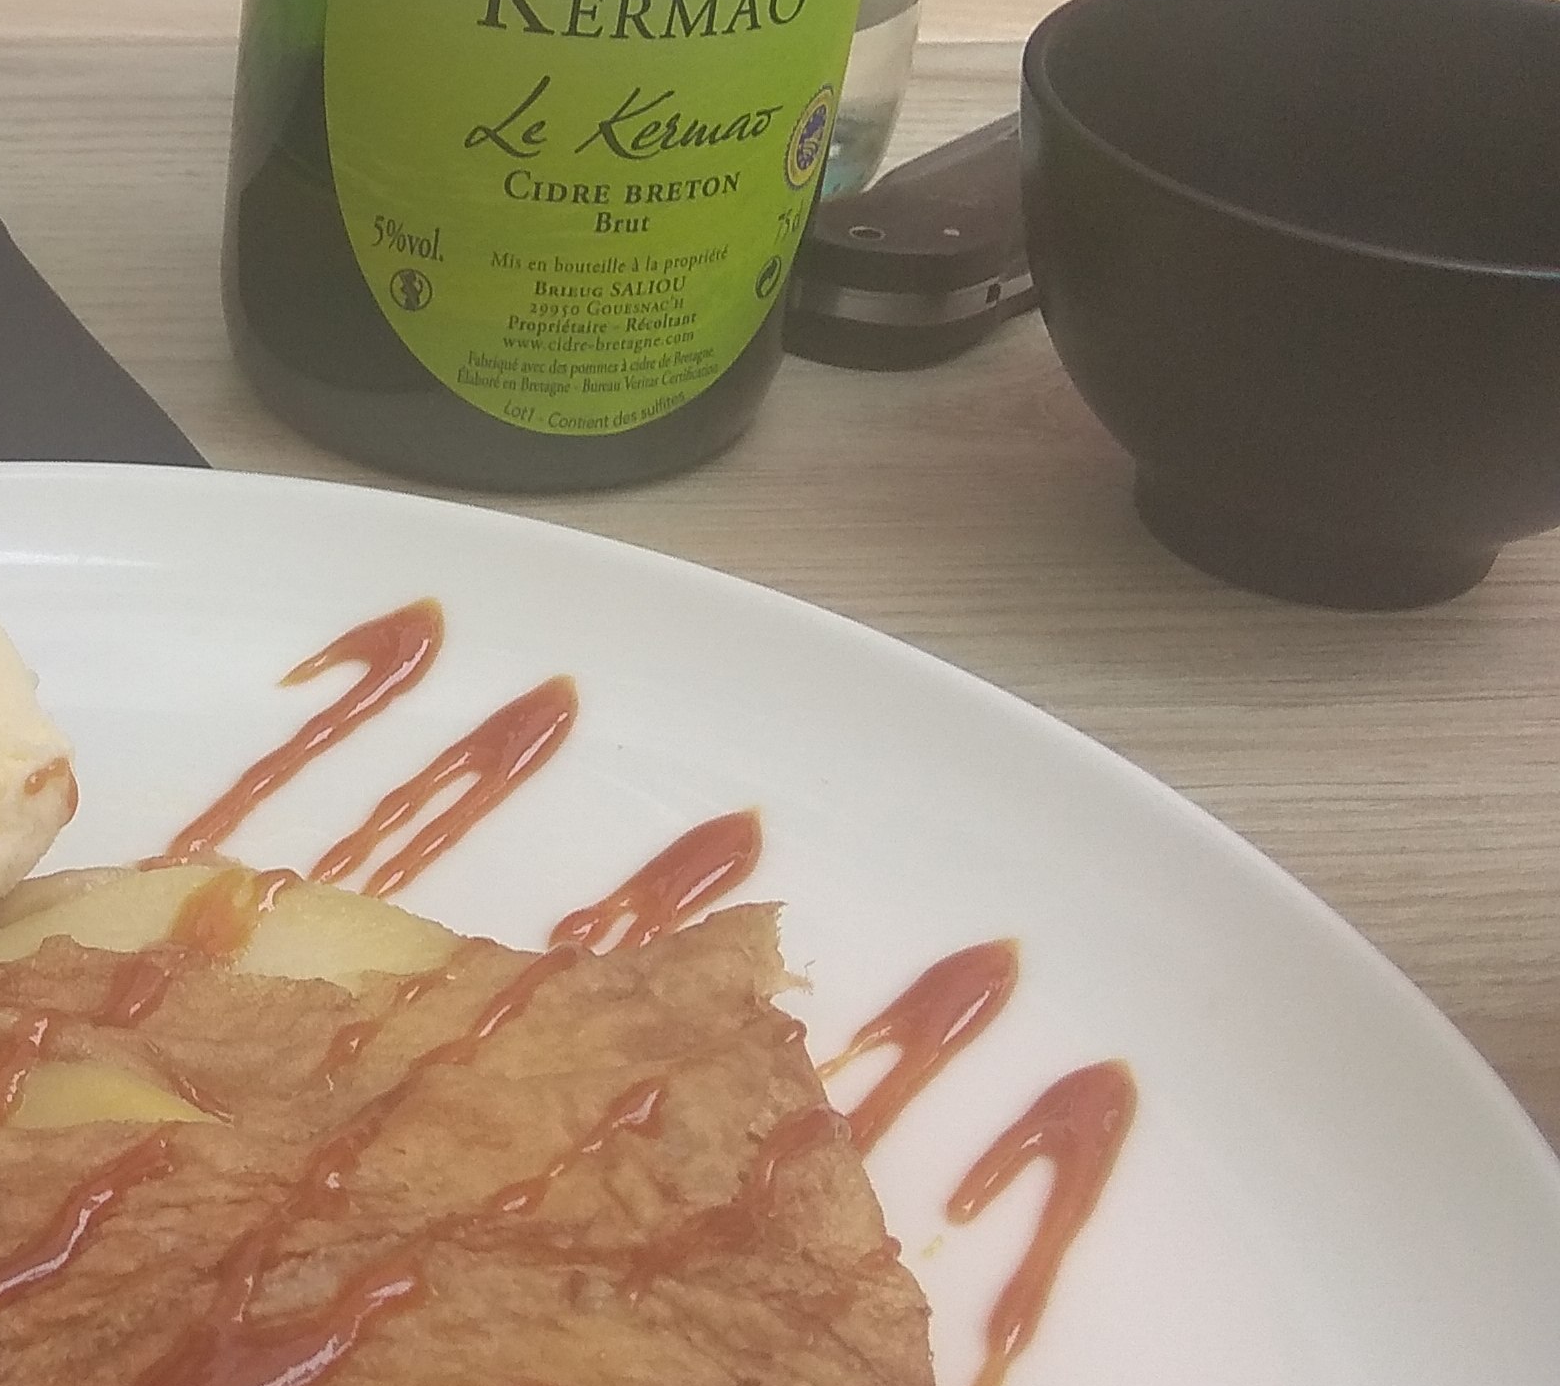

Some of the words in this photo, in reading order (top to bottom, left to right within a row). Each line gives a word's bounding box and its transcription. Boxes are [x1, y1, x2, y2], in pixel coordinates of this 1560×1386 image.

[464, 75, 551, 158] Le
[574, 87, 784, 160] Kermao
[503, 170, 610, 204] CIDRE
[624, 171, 740, 204] BRETON
[595, 212, 650, 233] Brut
[491, 251, 521, 269] Mis
[528, 260, 547, 272] en
[554, 256, 626, 273] bouteille
[646, 255, 658, 271] la
[664, 244, 728, 274] propriété
[610, 275, 686, 297] SALIOU
[530, 302, 580, 317] 29950
[508, 314, 608, 337] Propriétaire
[625, 313, 697, 332] Récoltant
[503, 331, 694, 353] www.cidre-bretagne.com
[468, 350, 518, 373] Fabriqué
[521, 363, 546, 373] avec
[549, 358, 567, 373] des
[570, 363, 619, 378] pommes
[630, 355, 656, 372] cidre
[658, 353, 671, 368] de
[503, 380, 517, 390] en
[521, 376, 571, 397] Bretagne
[582, 377, 620, 393] Bureau
[548, 411, 609, 429] Contient
[613, 410, 637, 428] des
